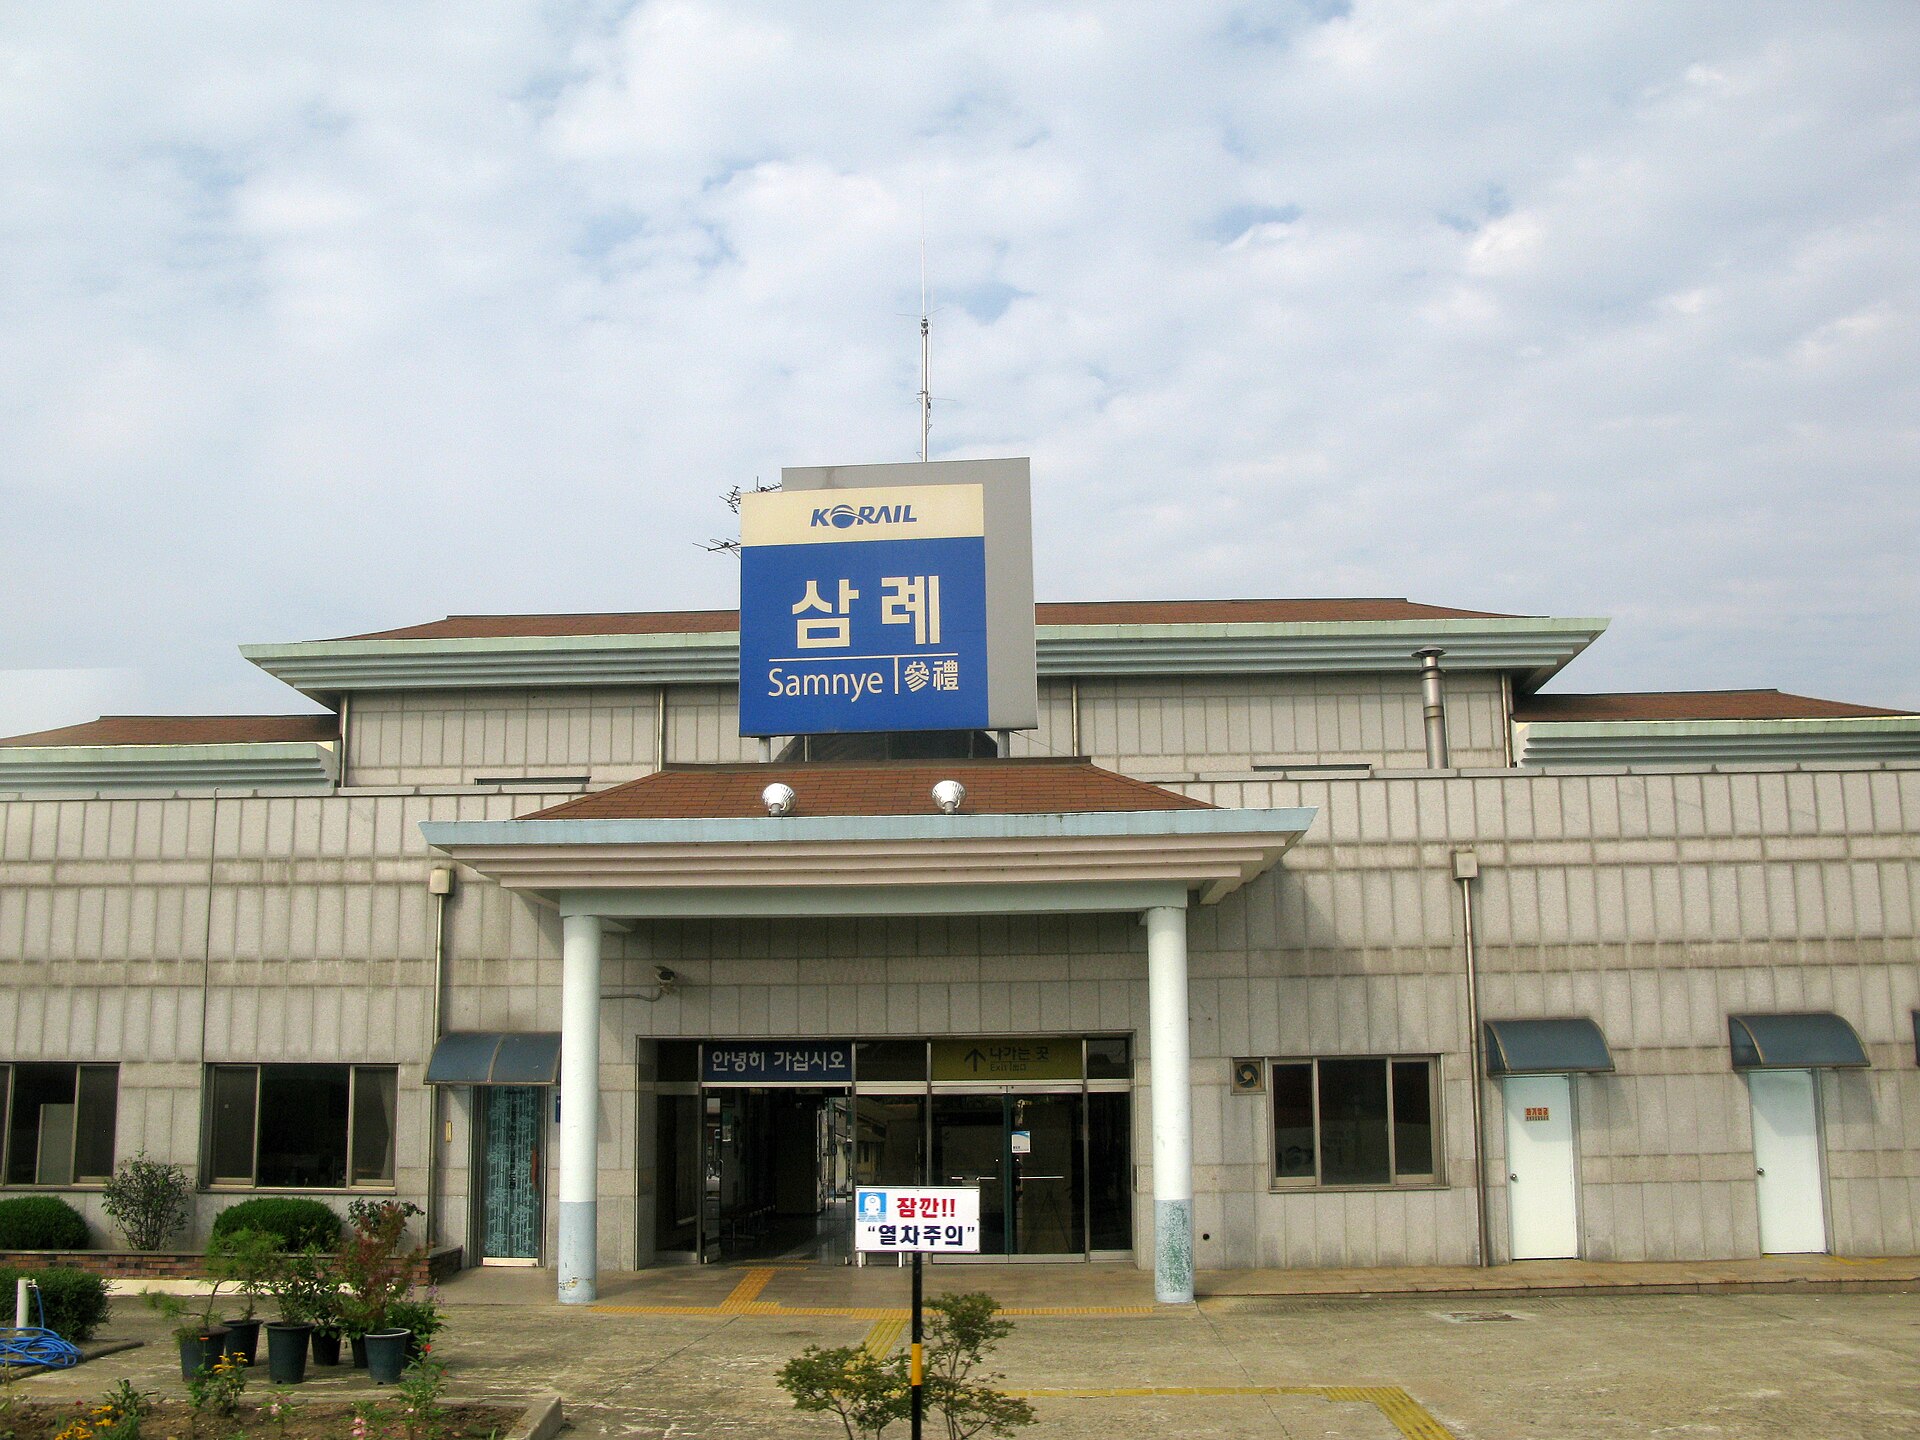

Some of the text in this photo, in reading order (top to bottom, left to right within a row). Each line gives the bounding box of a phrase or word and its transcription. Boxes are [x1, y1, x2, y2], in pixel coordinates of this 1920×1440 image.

[810, 504, 918, 529] KORAIL
[791, 575, 941, 649] 삼례
[768, 667, 883, 703] Samnye
[712, 1051, 846, 1072] 안녕히 가십시오
[990, 1046, 1049, 1061] 나가는 곳
[897, 1198, 955, 1218] 잠깐!!
